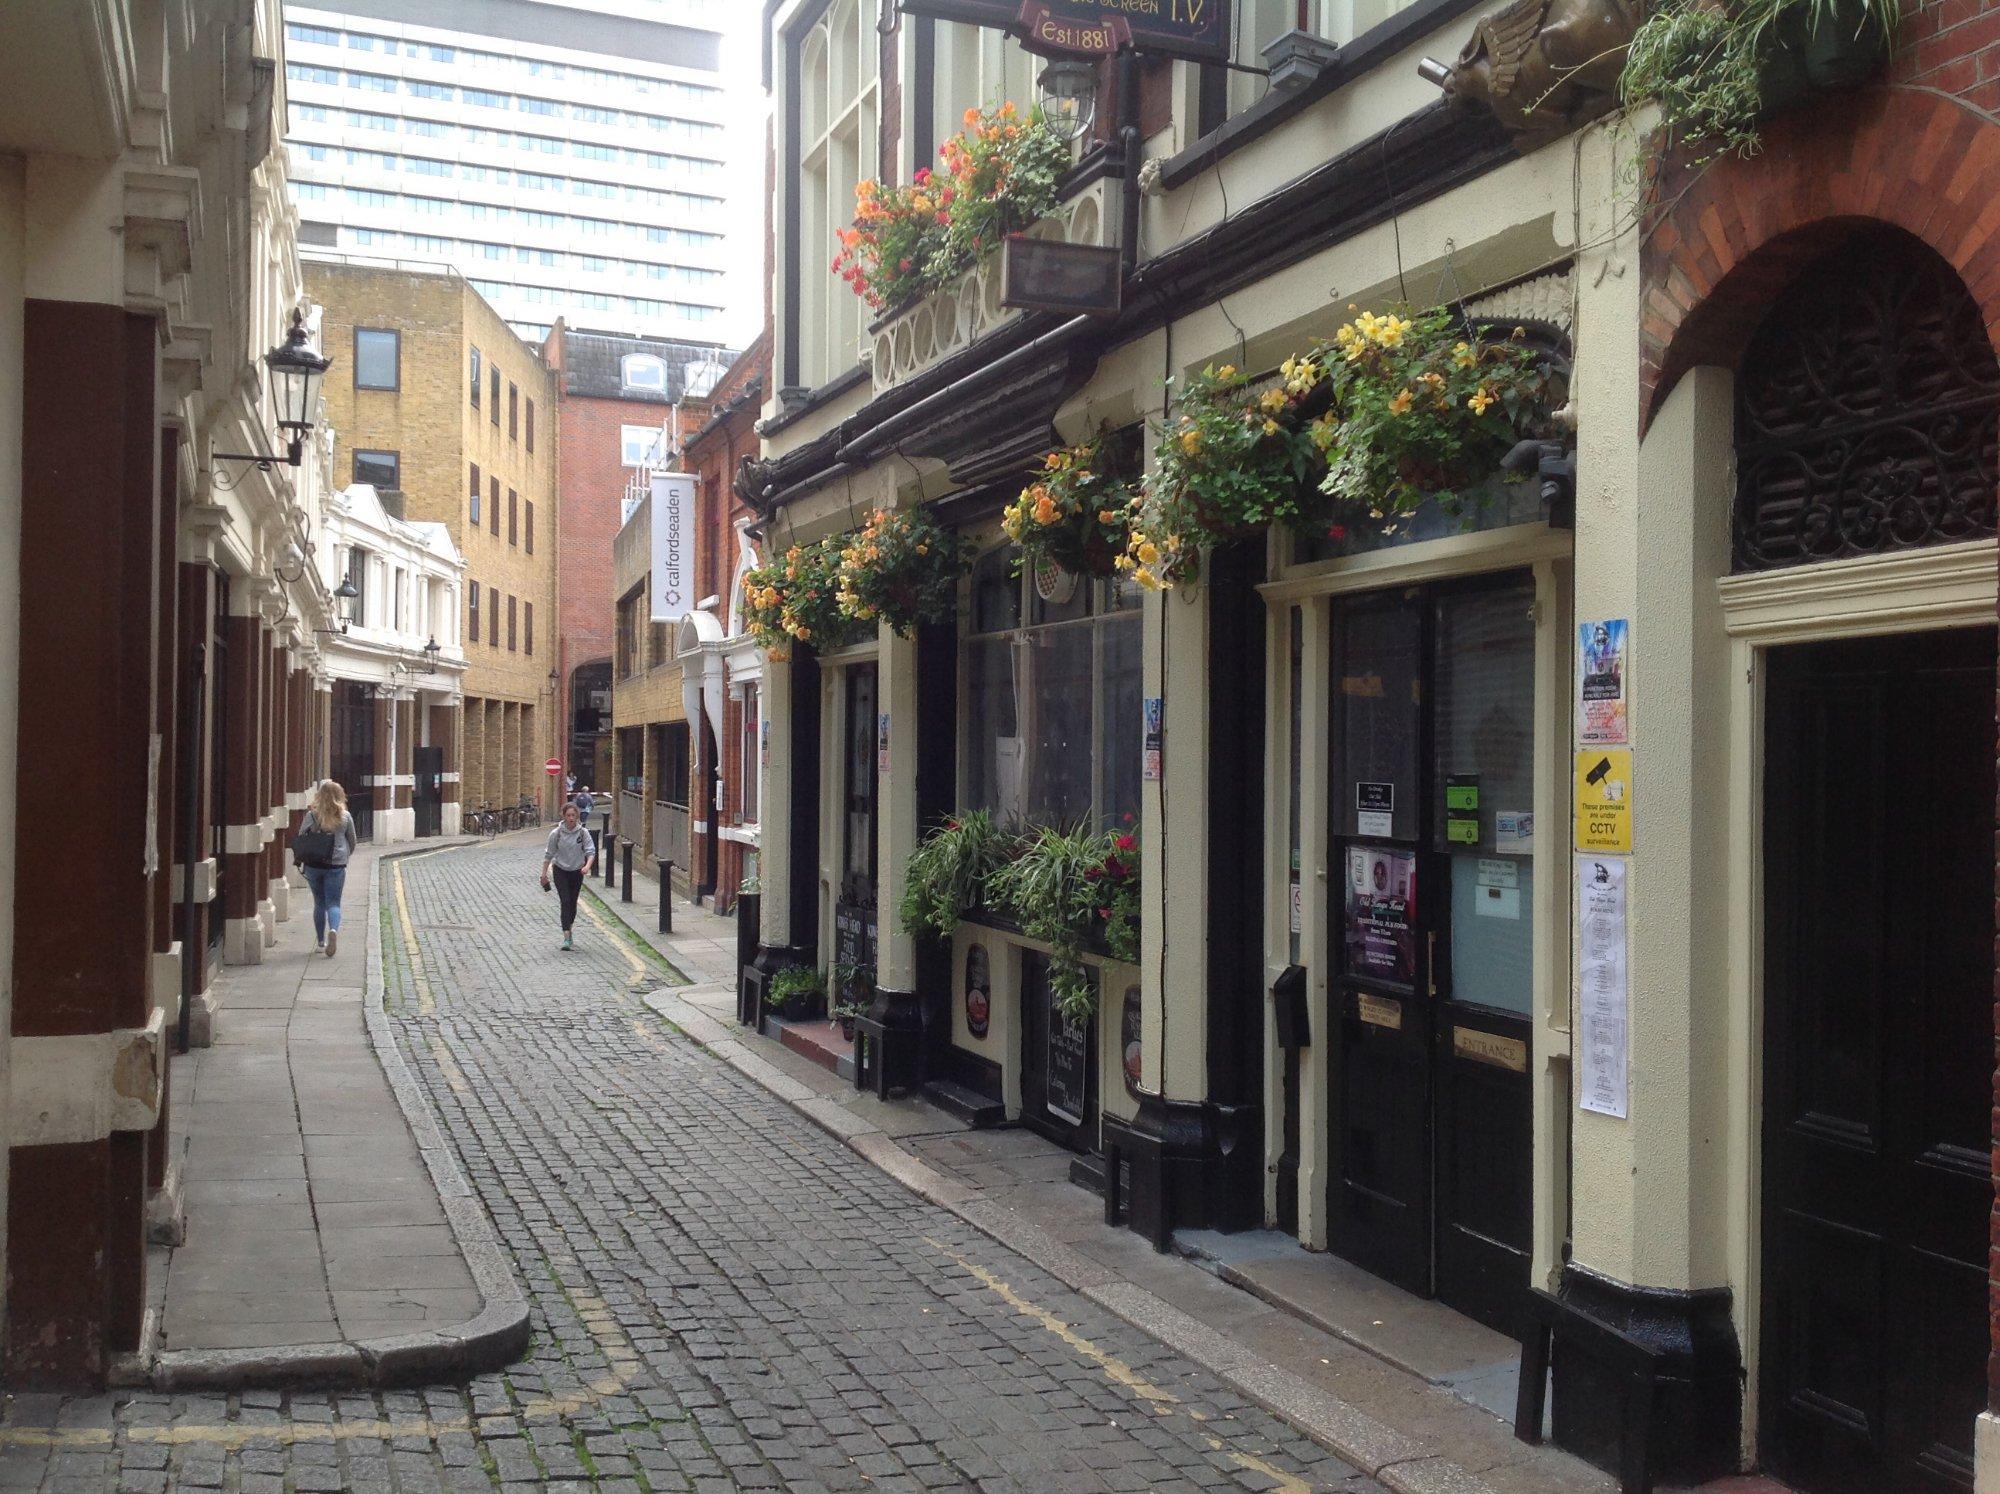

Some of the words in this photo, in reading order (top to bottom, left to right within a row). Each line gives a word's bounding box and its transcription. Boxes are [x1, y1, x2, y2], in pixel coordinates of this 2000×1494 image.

[664, 488, 680, 588] calfordseaden
[1582, 803, 1599, 811] These
[1599, 803, 1625, 811] premises
[1590, 811, 1599, 819] are
[1599, 811, 1617, 820] under
[1589, 822, 1616, 834] CCTV
[1586, 837, 1621, 847] surveillance
[1462, 1036, 1516, 1060] ENTRANCE
